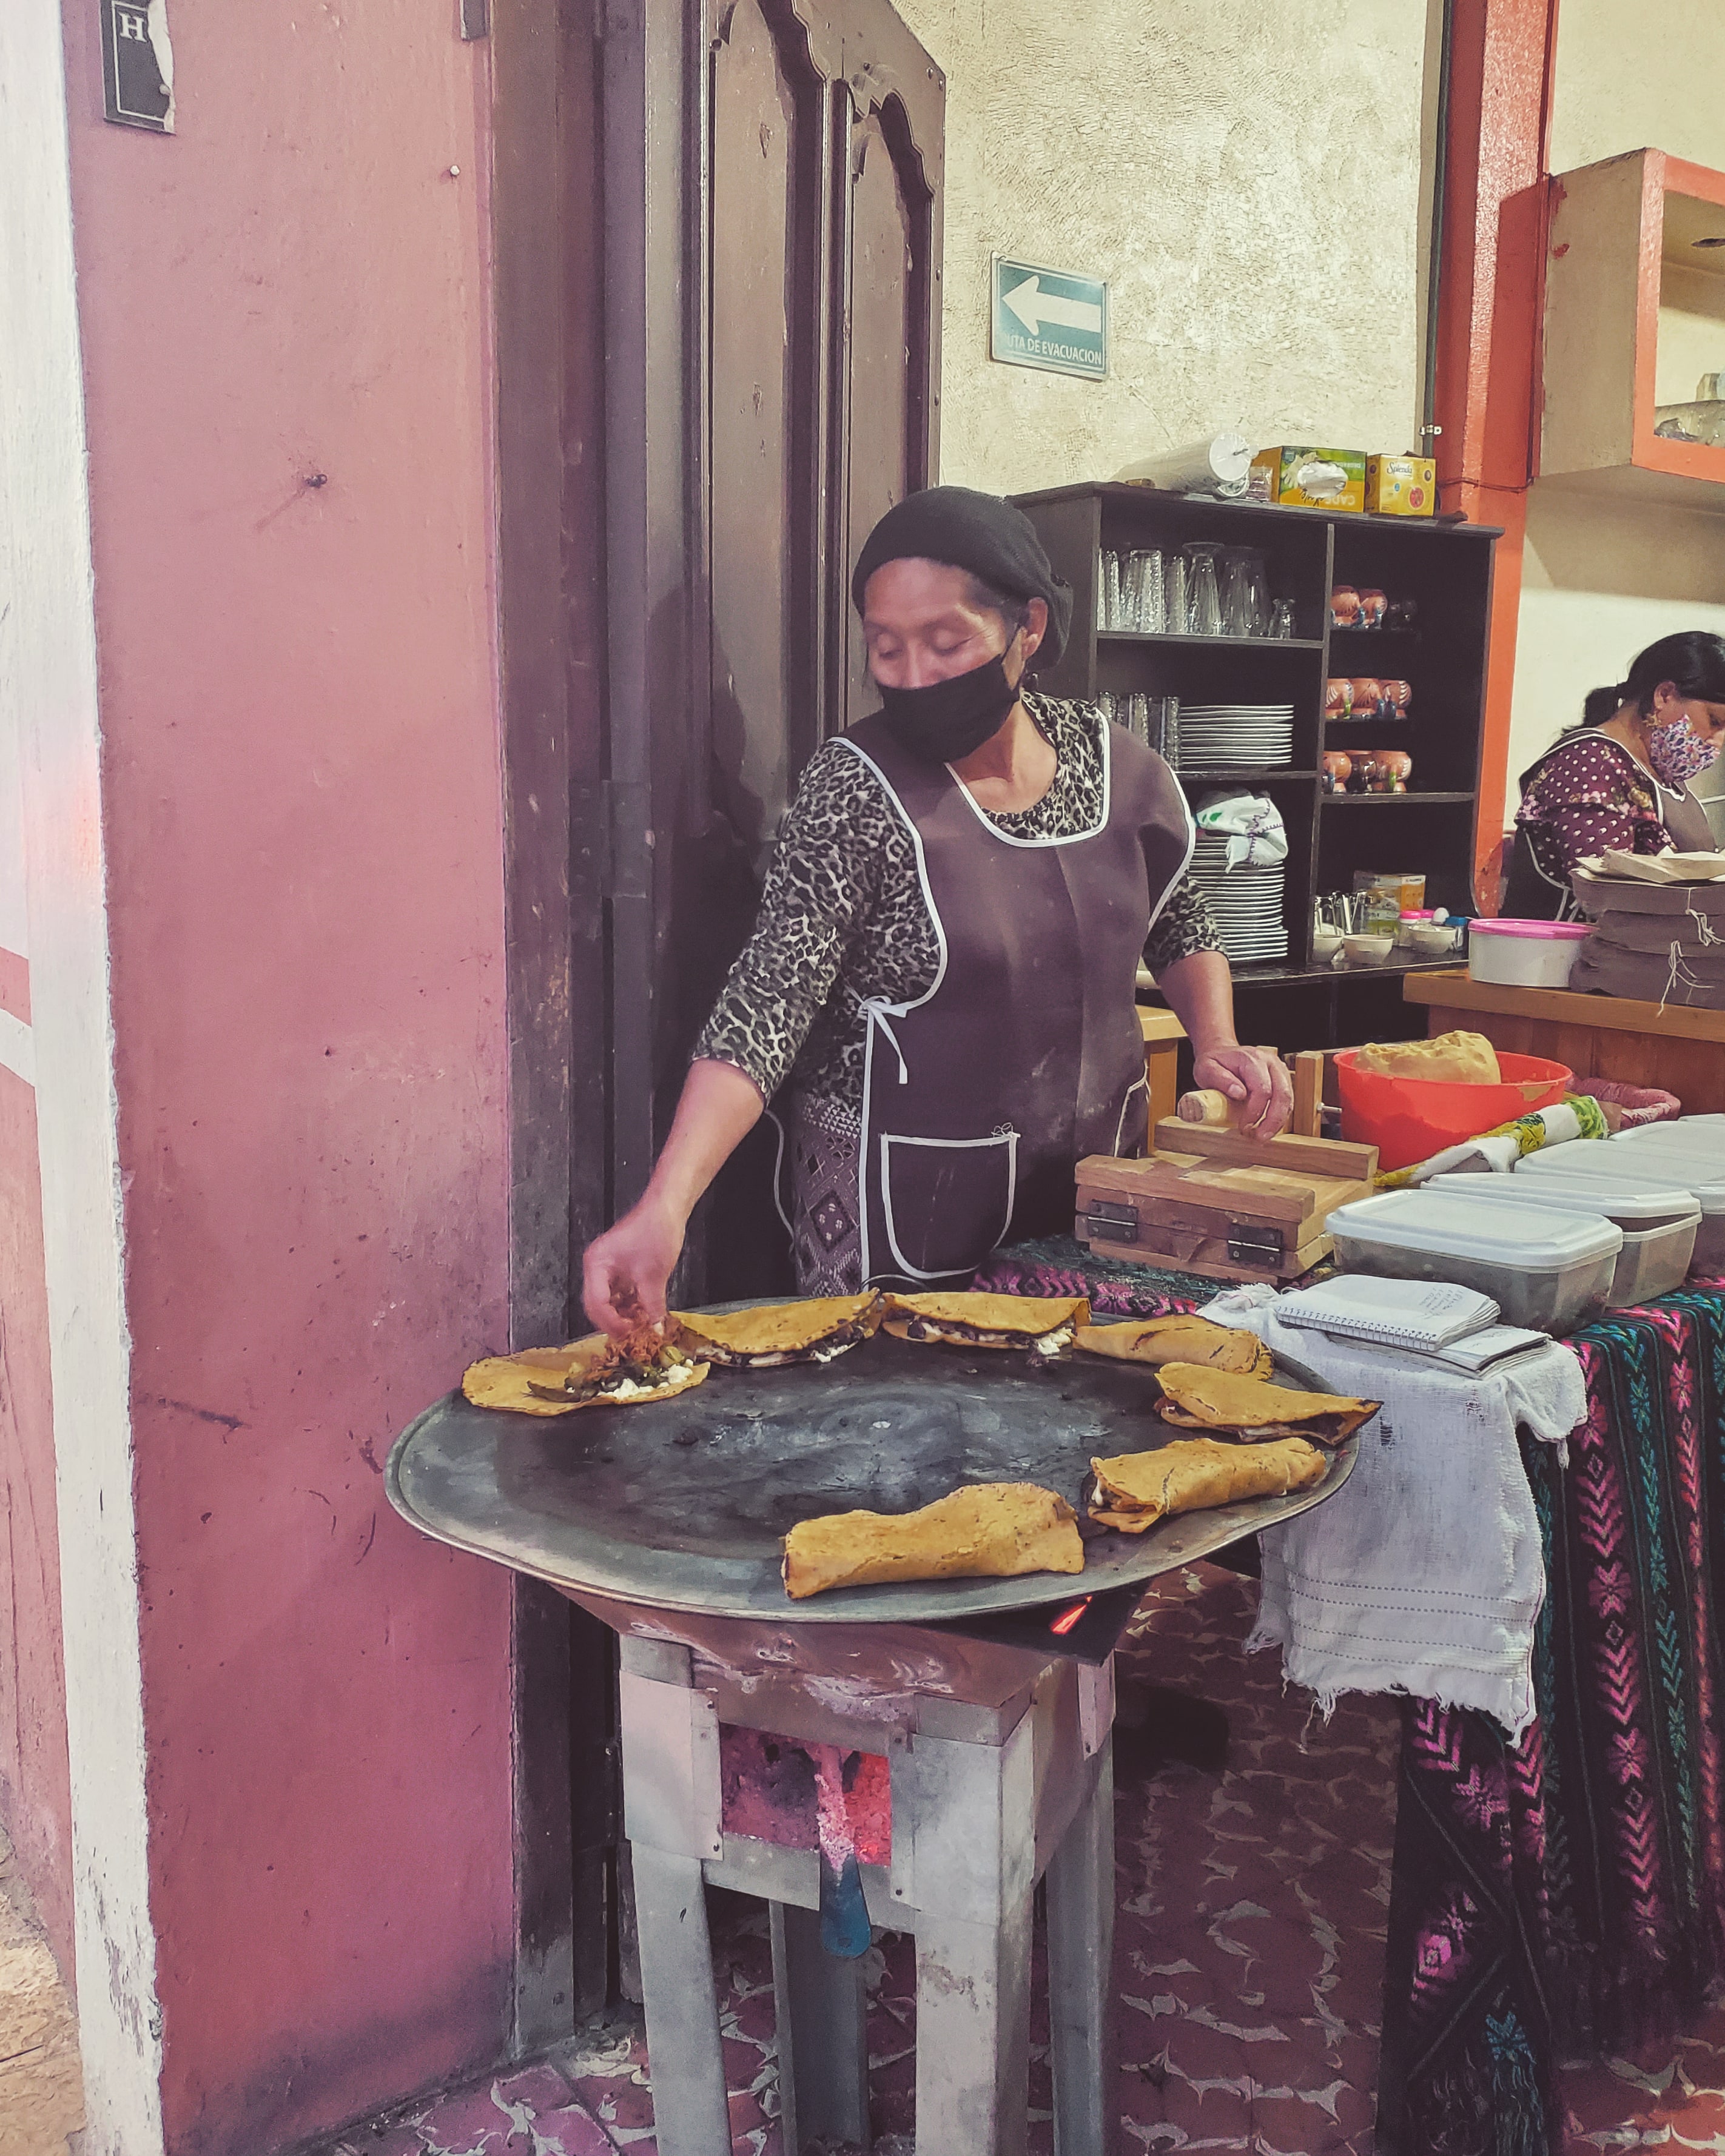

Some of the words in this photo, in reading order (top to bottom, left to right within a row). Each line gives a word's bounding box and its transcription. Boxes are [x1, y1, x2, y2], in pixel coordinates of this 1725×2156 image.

[1004, 332, 1025, 350] UTA
[1027, 338, 1041, 353] DE
[1042, 341, 1101, 364] EVACUACION
[1387, 462, 1413, 475] Splenda
